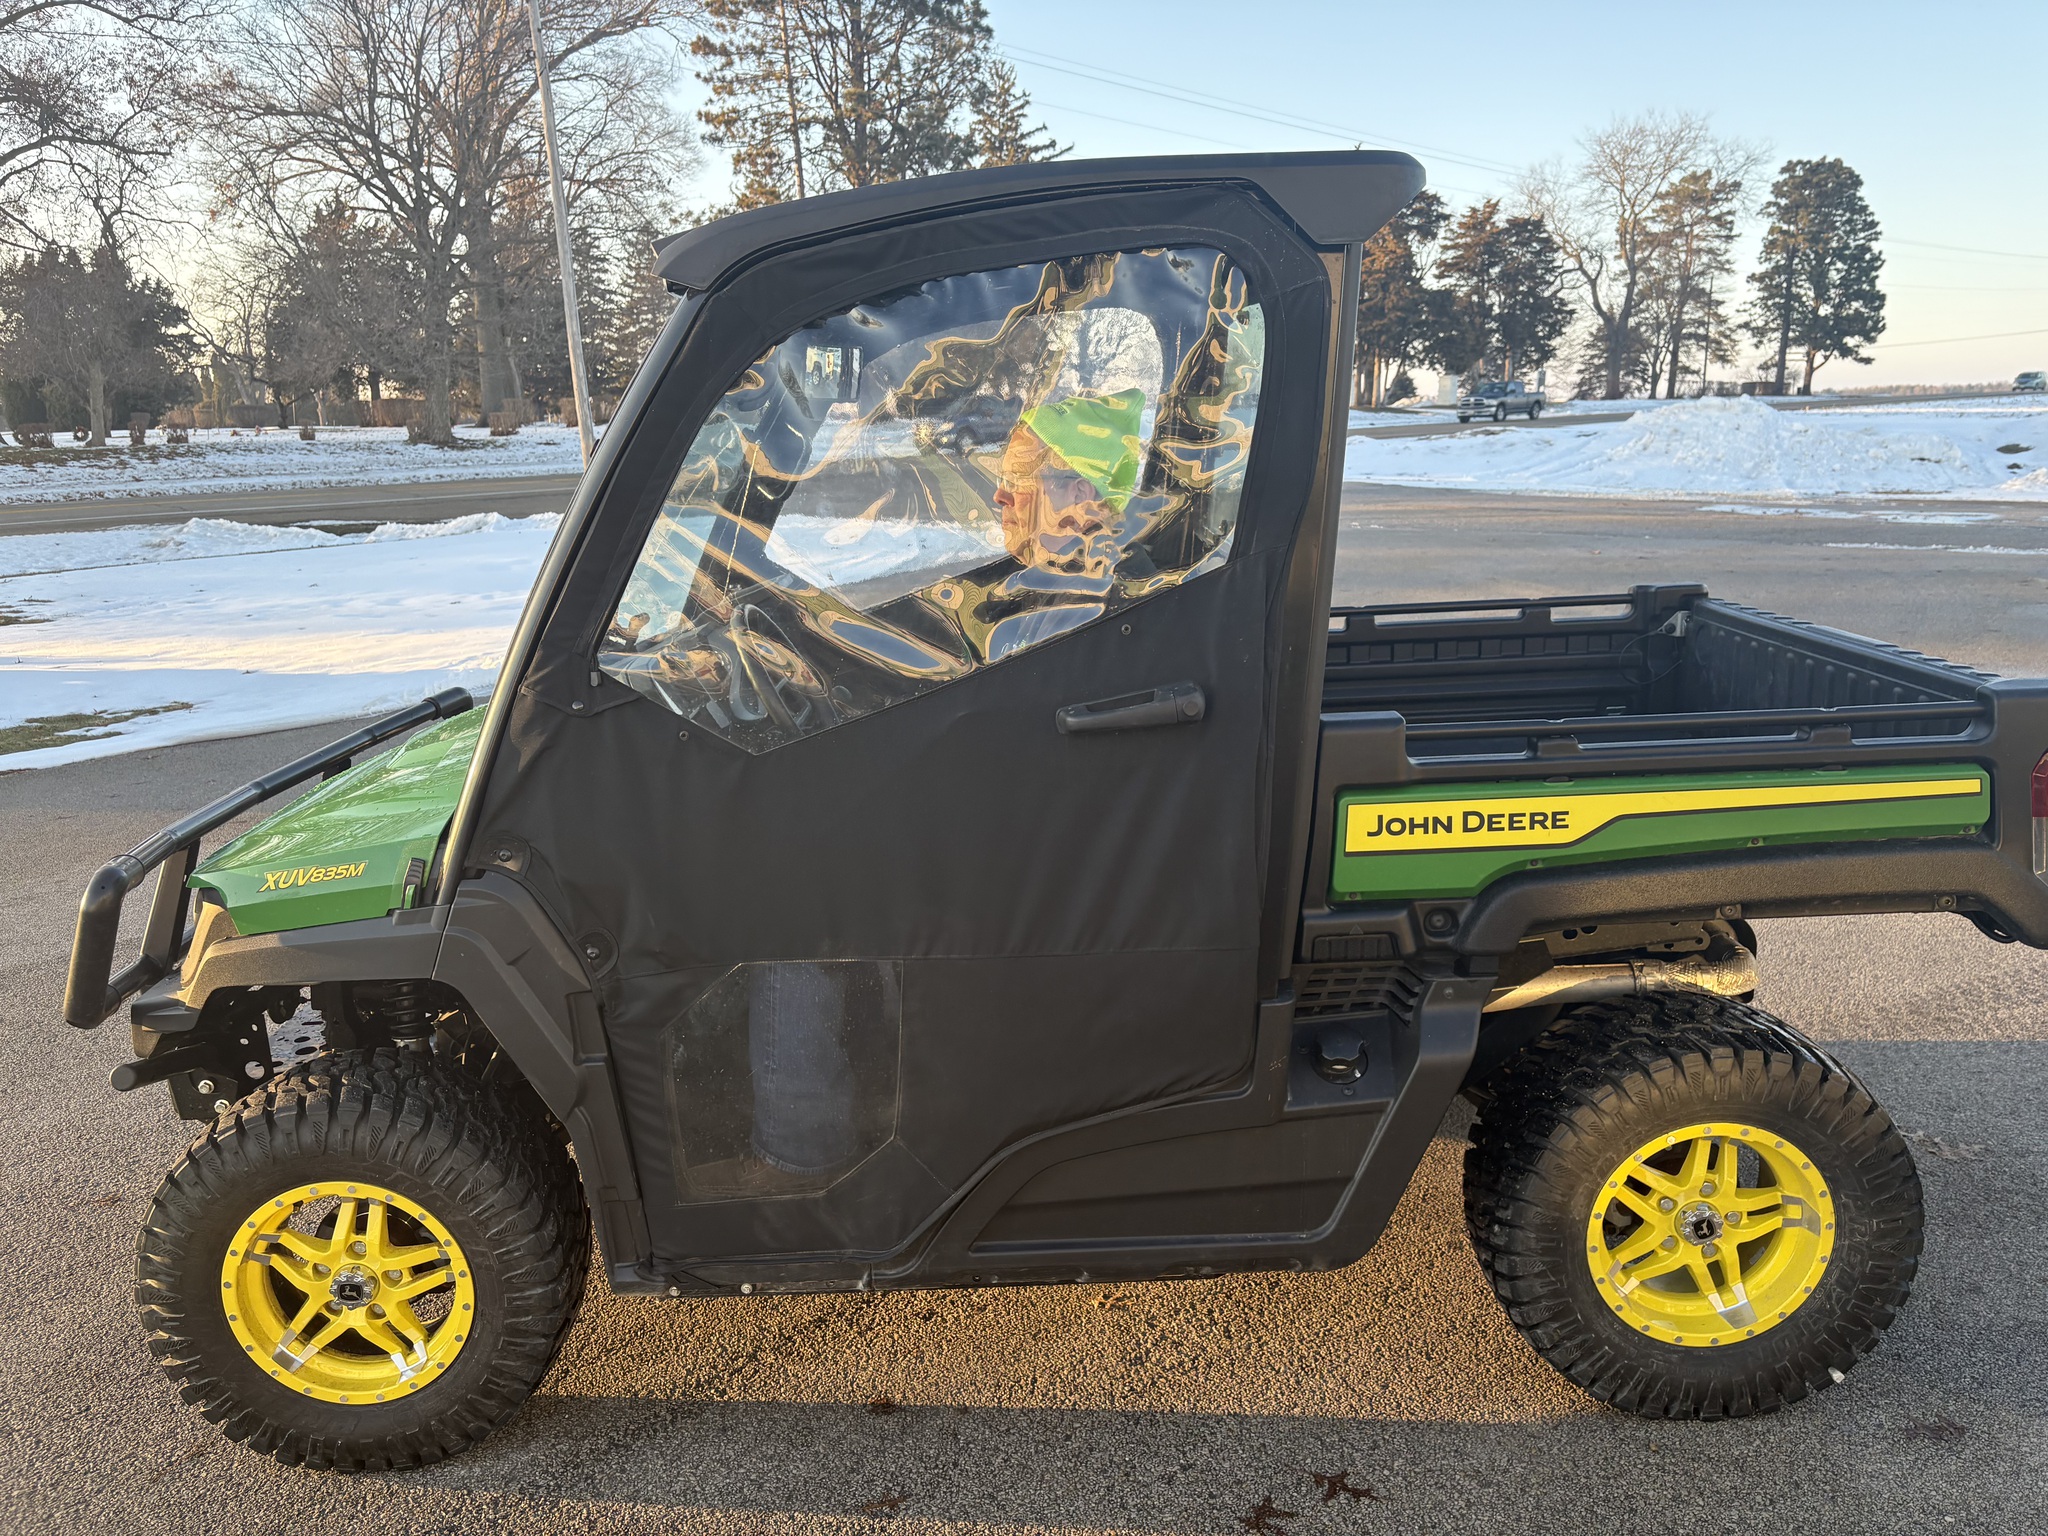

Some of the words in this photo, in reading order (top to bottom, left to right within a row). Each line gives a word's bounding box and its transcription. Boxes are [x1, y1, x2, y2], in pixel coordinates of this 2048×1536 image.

[1367, 815, 1452, 837] JOHN
[1462, 811, 1569, 833] DEERE
[257, 862, 367, 892] XUV835M
